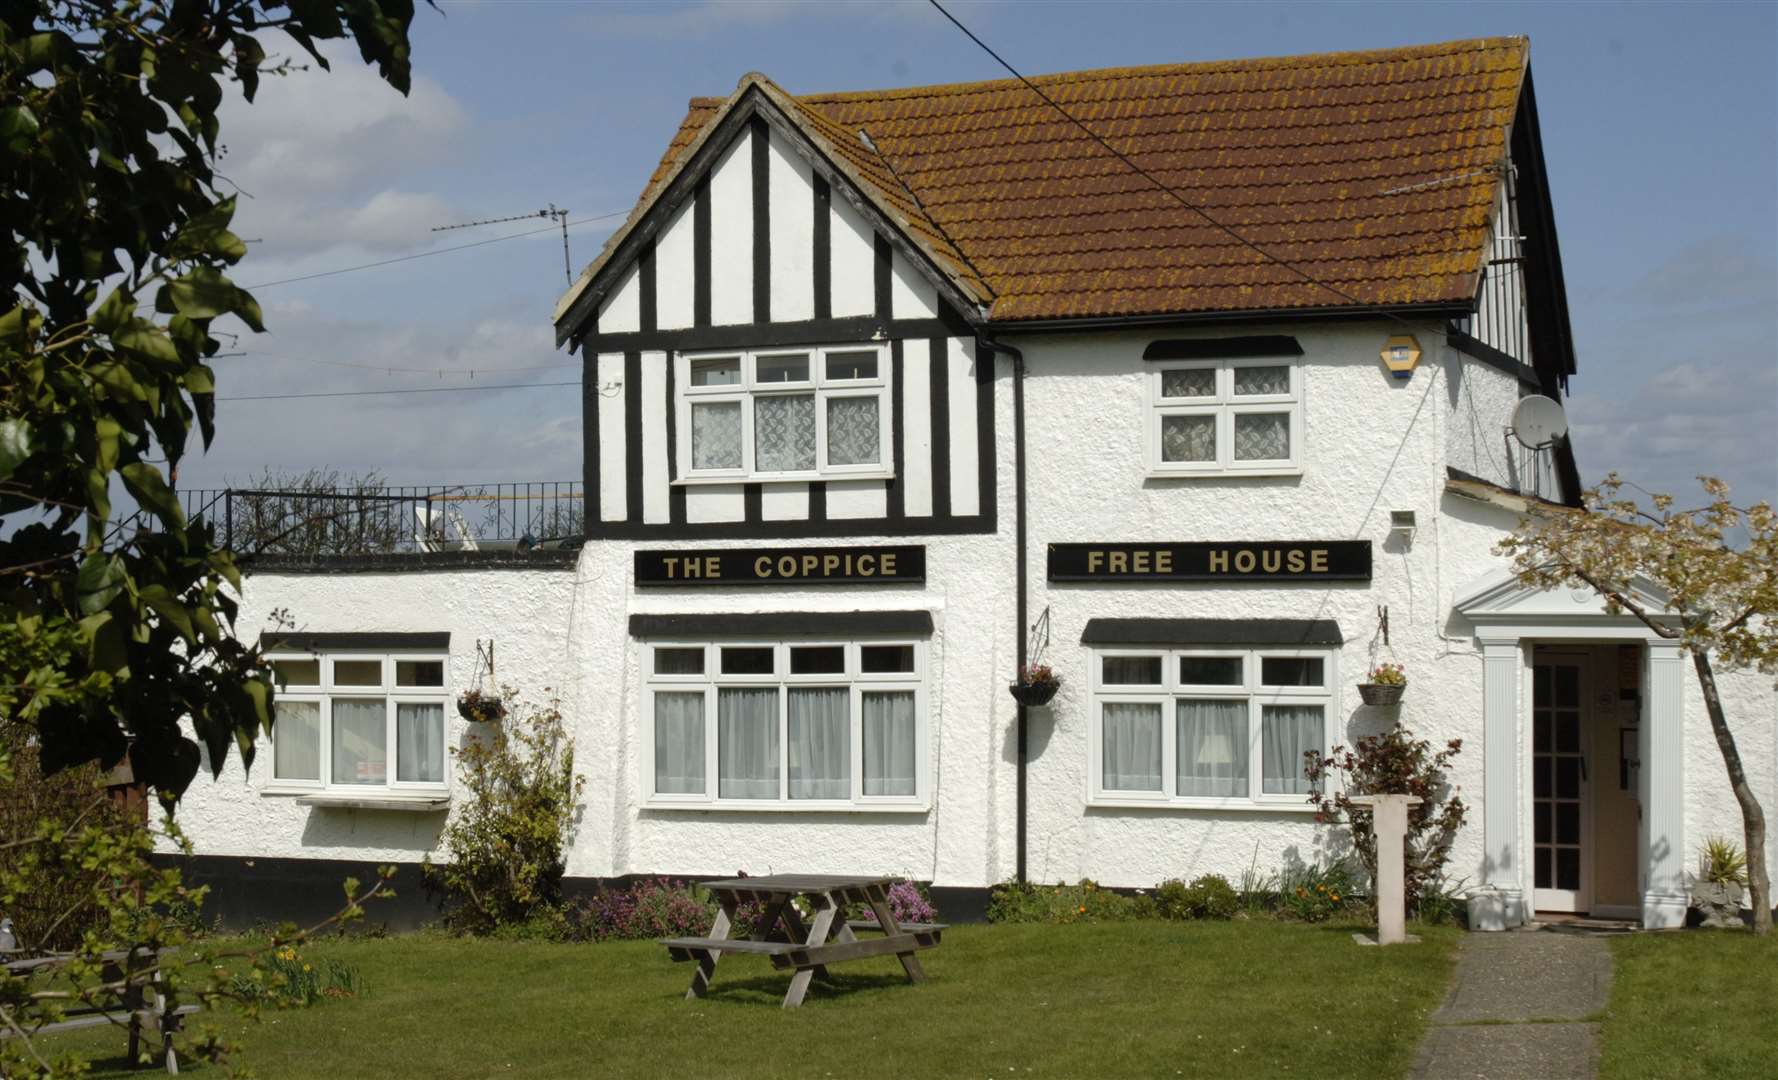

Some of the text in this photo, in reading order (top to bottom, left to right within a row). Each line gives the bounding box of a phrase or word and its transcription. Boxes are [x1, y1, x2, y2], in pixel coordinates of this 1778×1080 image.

[663, 554, 897, 578] THE COPPICE
[1088, 549, 1329, 573] FREE HOUSE
